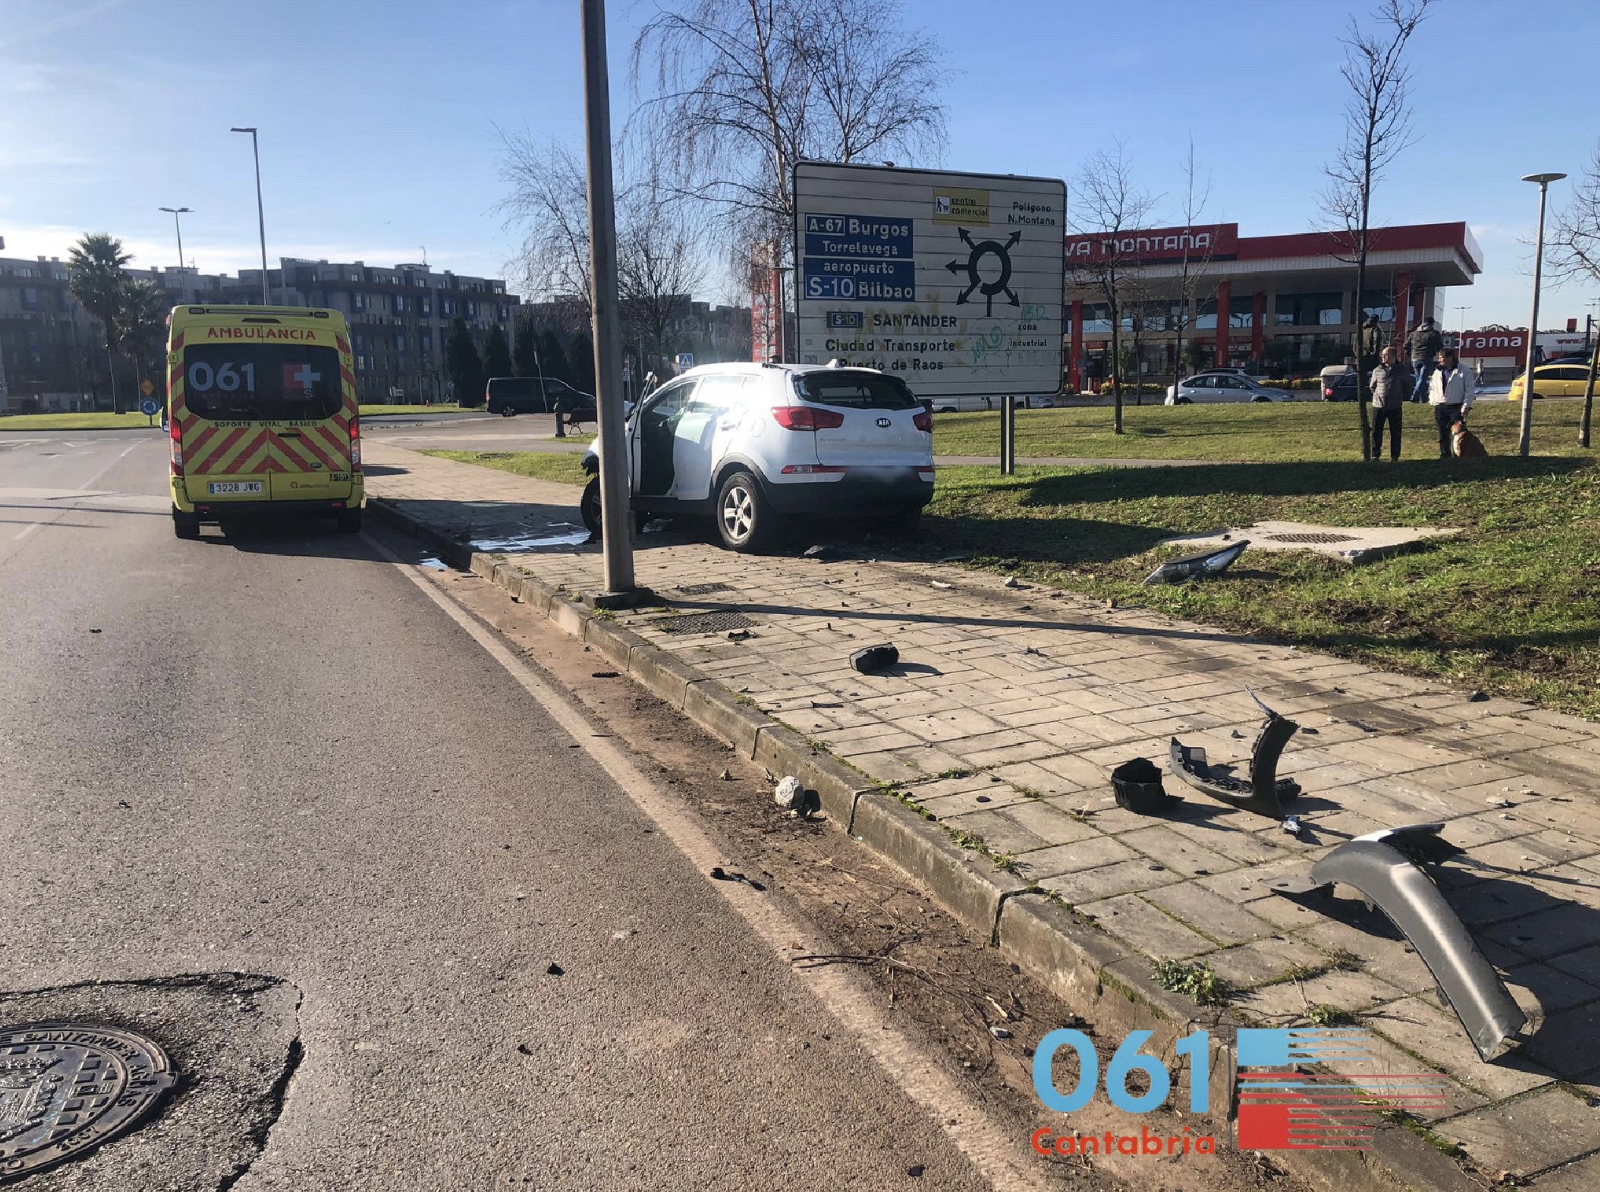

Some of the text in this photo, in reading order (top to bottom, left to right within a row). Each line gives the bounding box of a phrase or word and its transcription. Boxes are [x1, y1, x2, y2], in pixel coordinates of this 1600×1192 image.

[951, 197, 977, 206] centro
[951, 207, 988, 216] comercial
[809, 217, 909, 239] A-67 Burgos
[822, 240, 898, 257] Torrelavega
[823, 262, 895, 275] aeropuerto
[809, 276, 913, 299] S-10 Bilbao
[873, 314, 957, 328] SANTANDER
[1018, 323, 1038, 331] zona
[207, 327, 316, 340] AMBULANCIA
[825, 338, 956, 354] Ciudad Transporte
[891, 359, 907, 371] de
[913, 358, 944, 371] Raos
[188, 361, 256, 392] 061
[214, 420, 252, 428] SOPORTE
[259, 420, 283, 428] VITAL
[215, 483, 240, 493] 3228
[22, 1031, 141, 1061] SANTANDER
